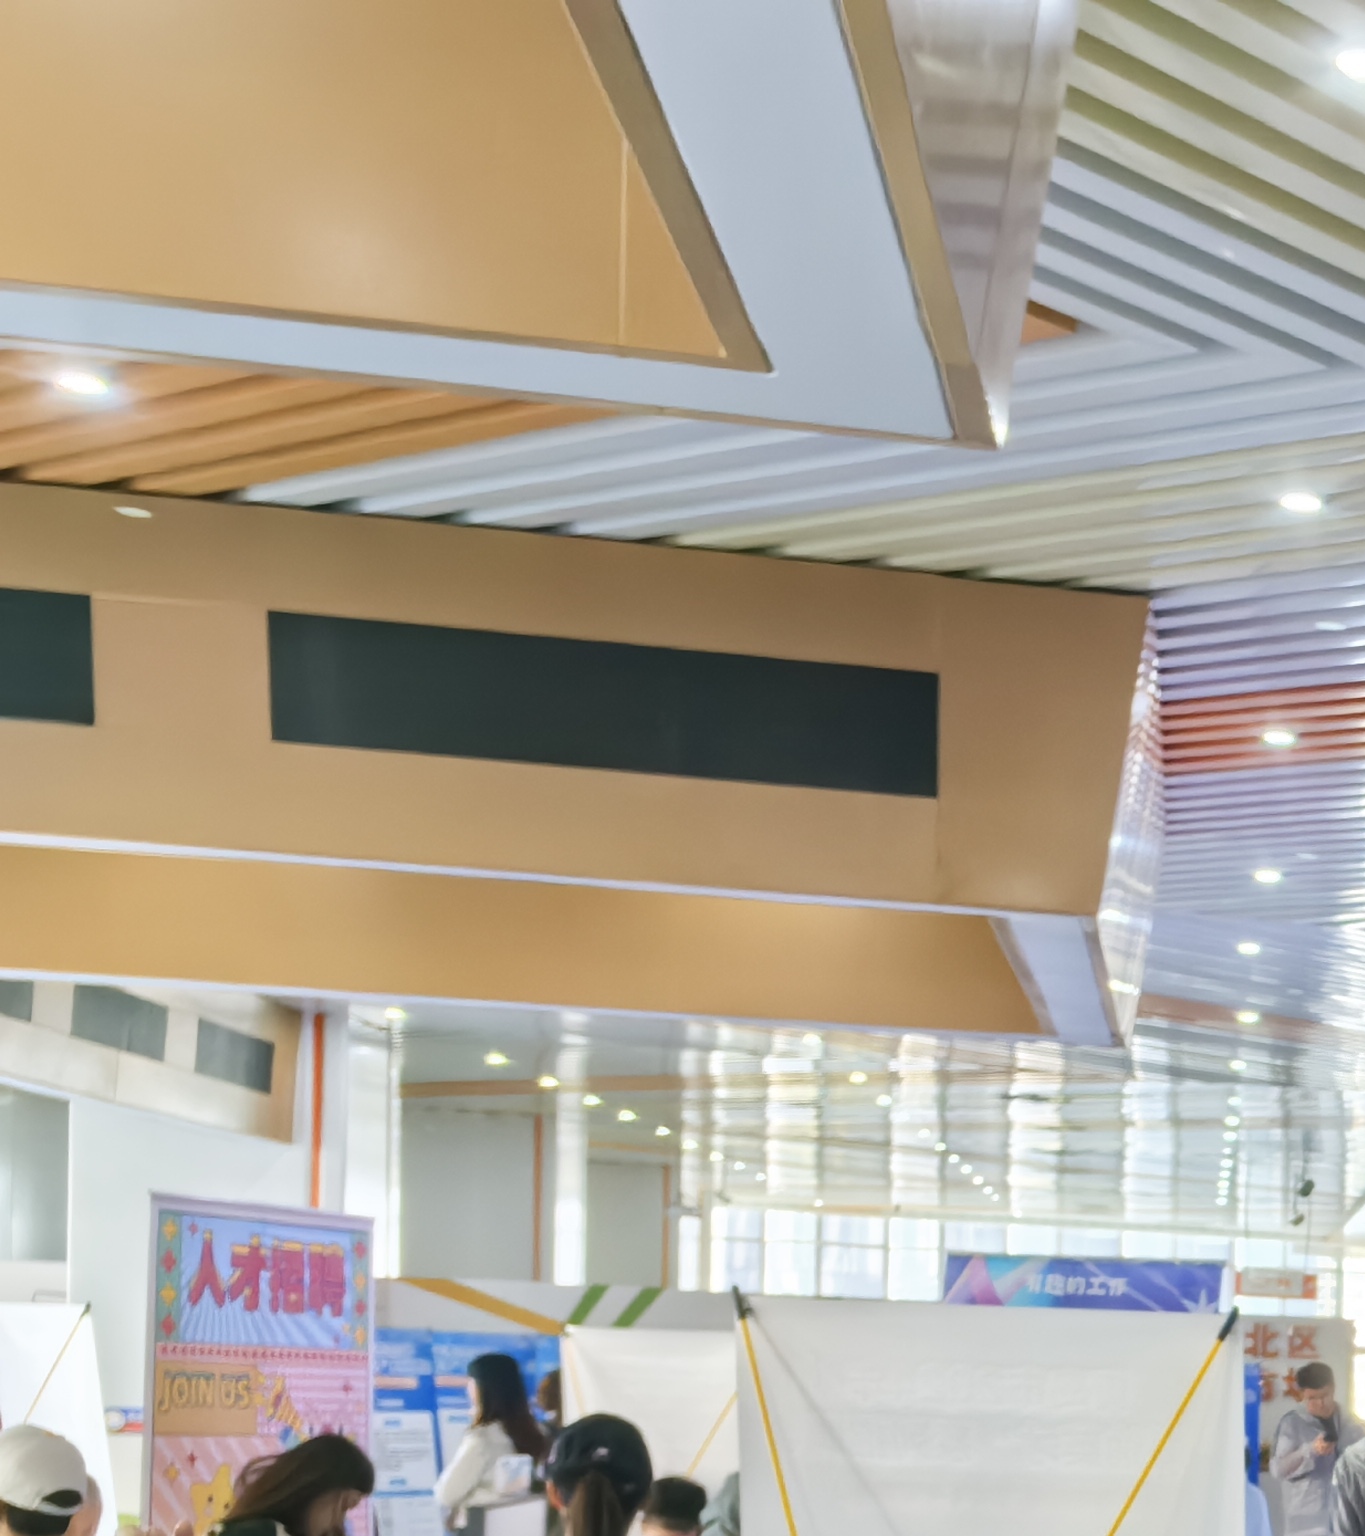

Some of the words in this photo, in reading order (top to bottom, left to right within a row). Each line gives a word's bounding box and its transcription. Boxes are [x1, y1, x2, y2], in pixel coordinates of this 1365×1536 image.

[187, 1229, 346, 1318] 人才招聘
[158, 1371, 215, 1413] JOIN
[220, 1373, 251, 1410] US
